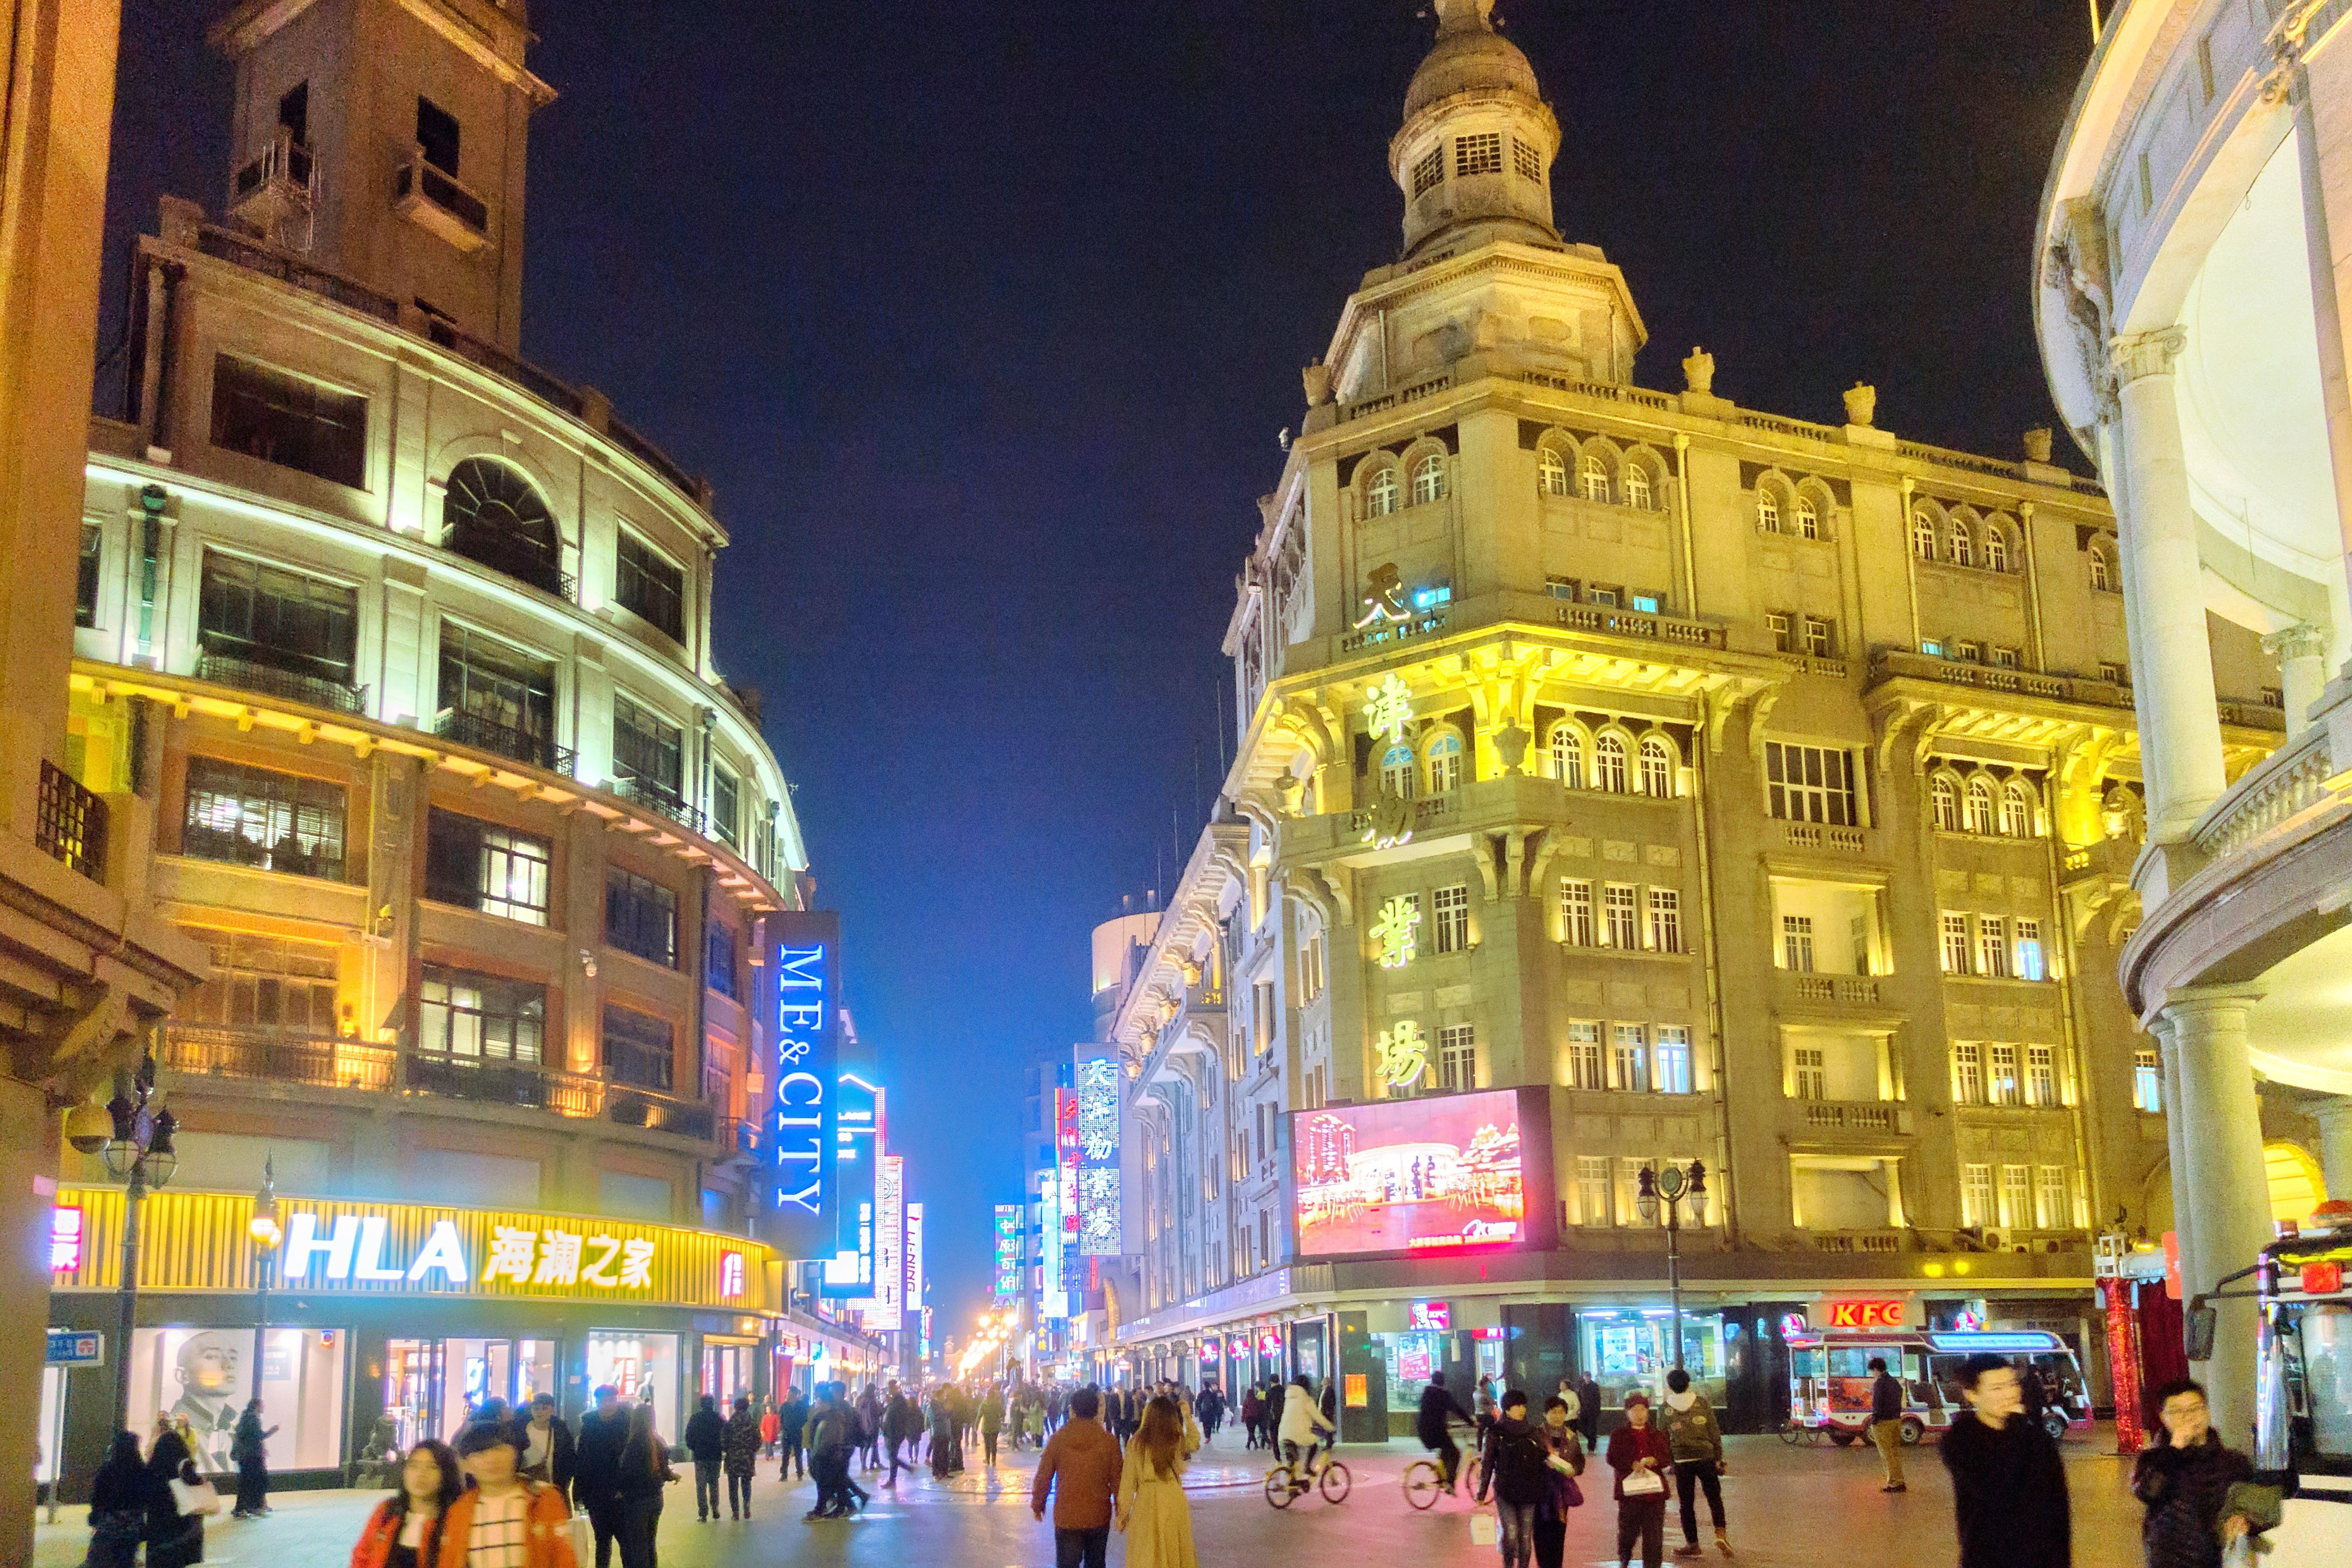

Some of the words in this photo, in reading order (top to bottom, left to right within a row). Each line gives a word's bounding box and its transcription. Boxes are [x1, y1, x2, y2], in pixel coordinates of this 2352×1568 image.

[284, 1214, 468, 1281] HLA
[482, 1225, 654, 1289] 海澜之家
[906, 1231, 915, 1292] LI-NING
[1833, 1301, 1903, 1327] KFC
